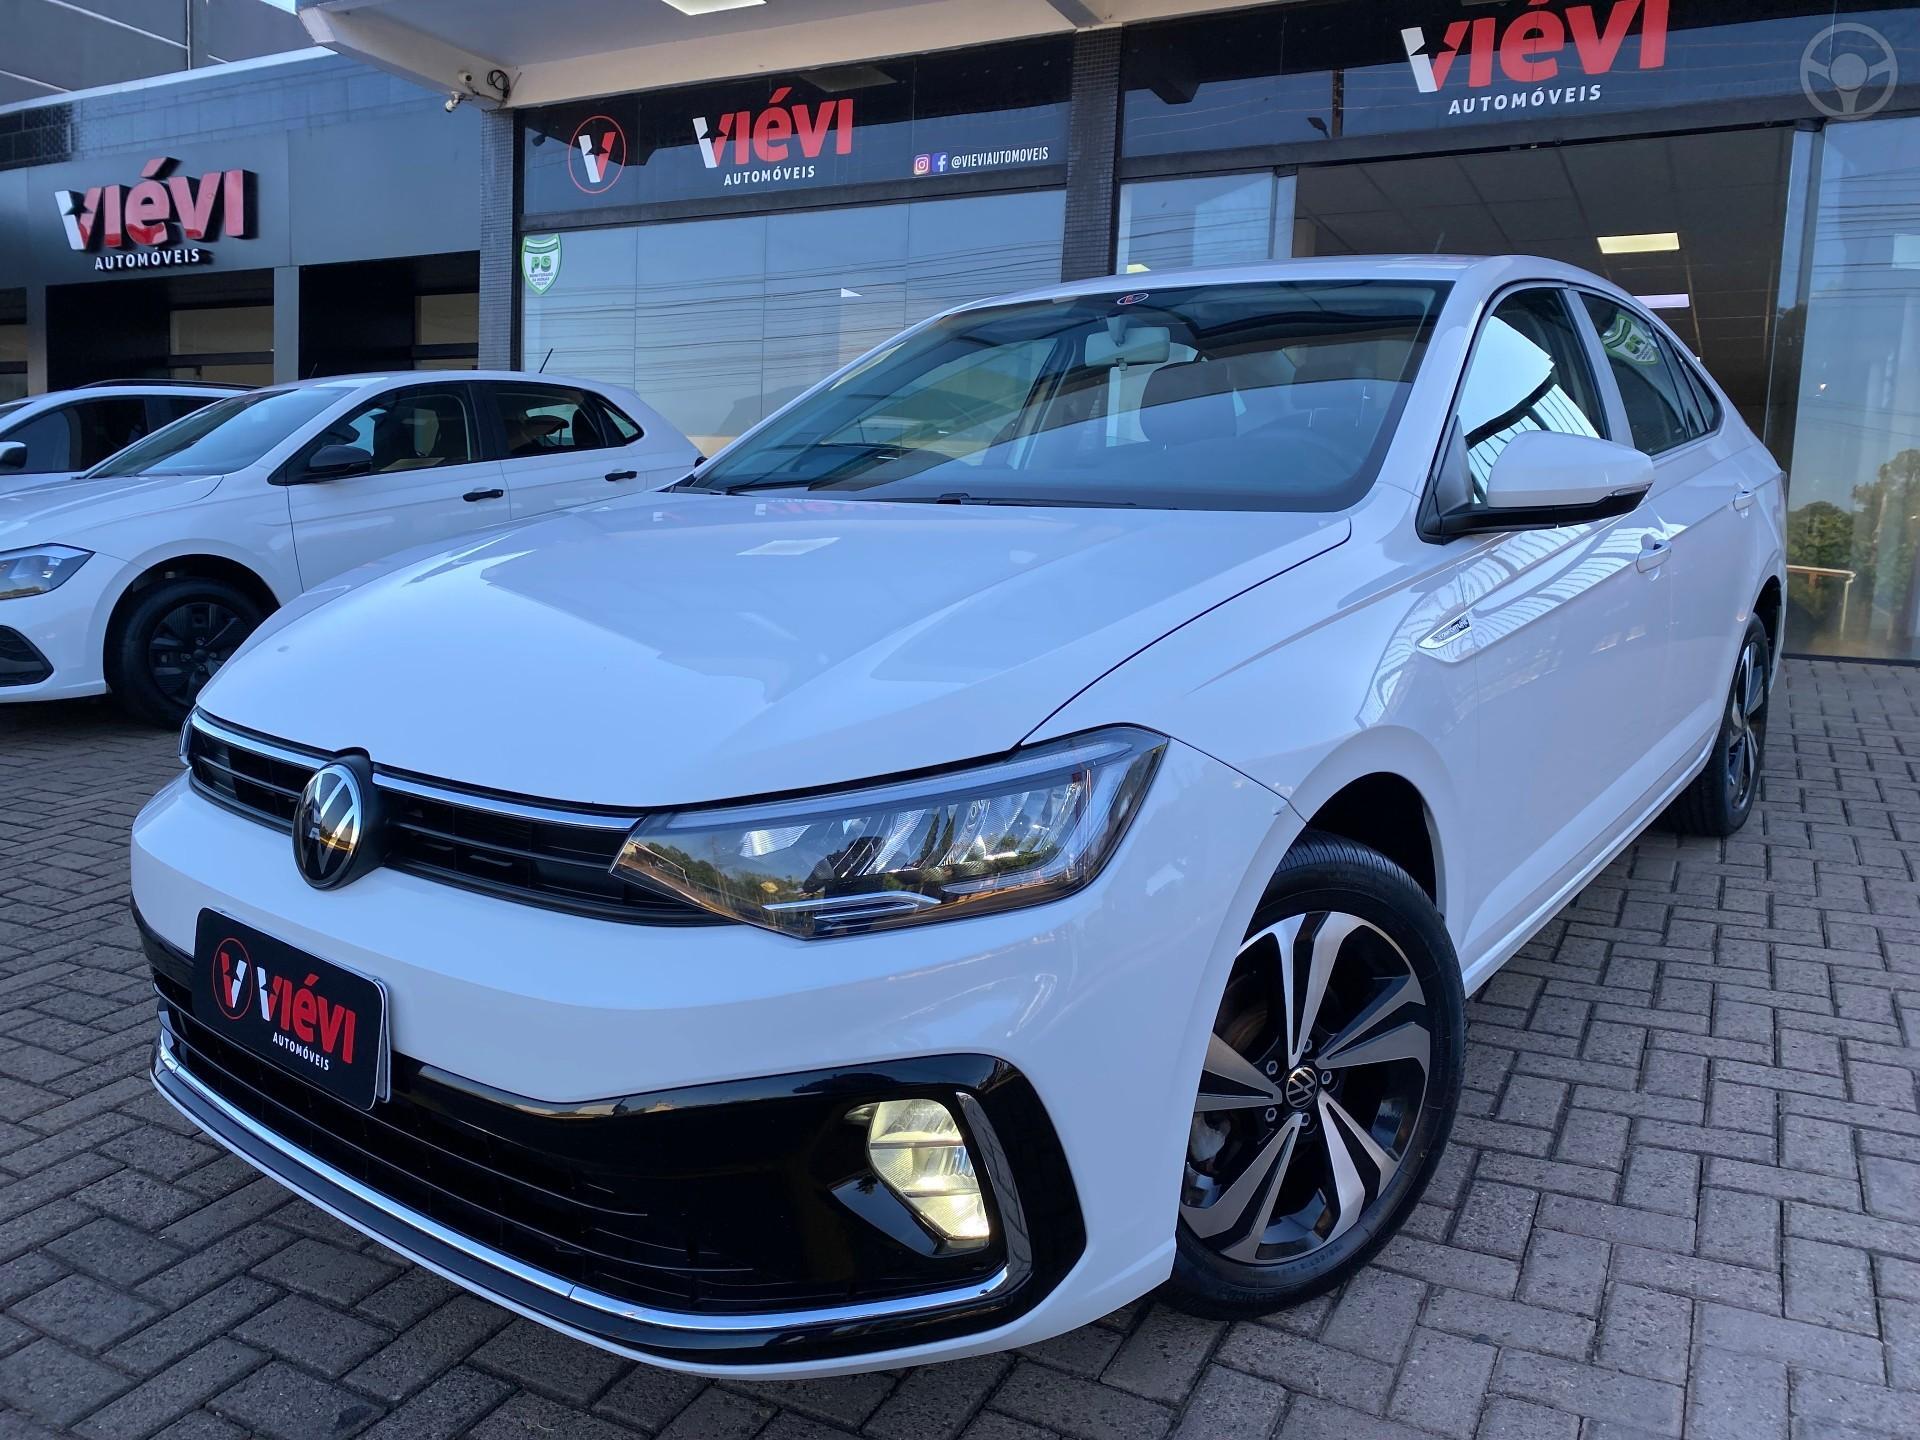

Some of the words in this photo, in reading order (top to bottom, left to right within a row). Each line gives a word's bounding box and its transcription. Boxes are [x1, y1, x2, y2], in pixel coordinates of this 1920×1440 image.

[1448, 84, 1602, 115] AUTOMÓVEIS
[951, 146, 1049, 169] @VIEVIAUTOMOVEIS
[723, 165, 816, 186] AUTOMÓVEIS
[94, 247, 200, 271] AUTOMÓVEIS
[272, 1031, 330, 1071] AUTOMÓVEIS
